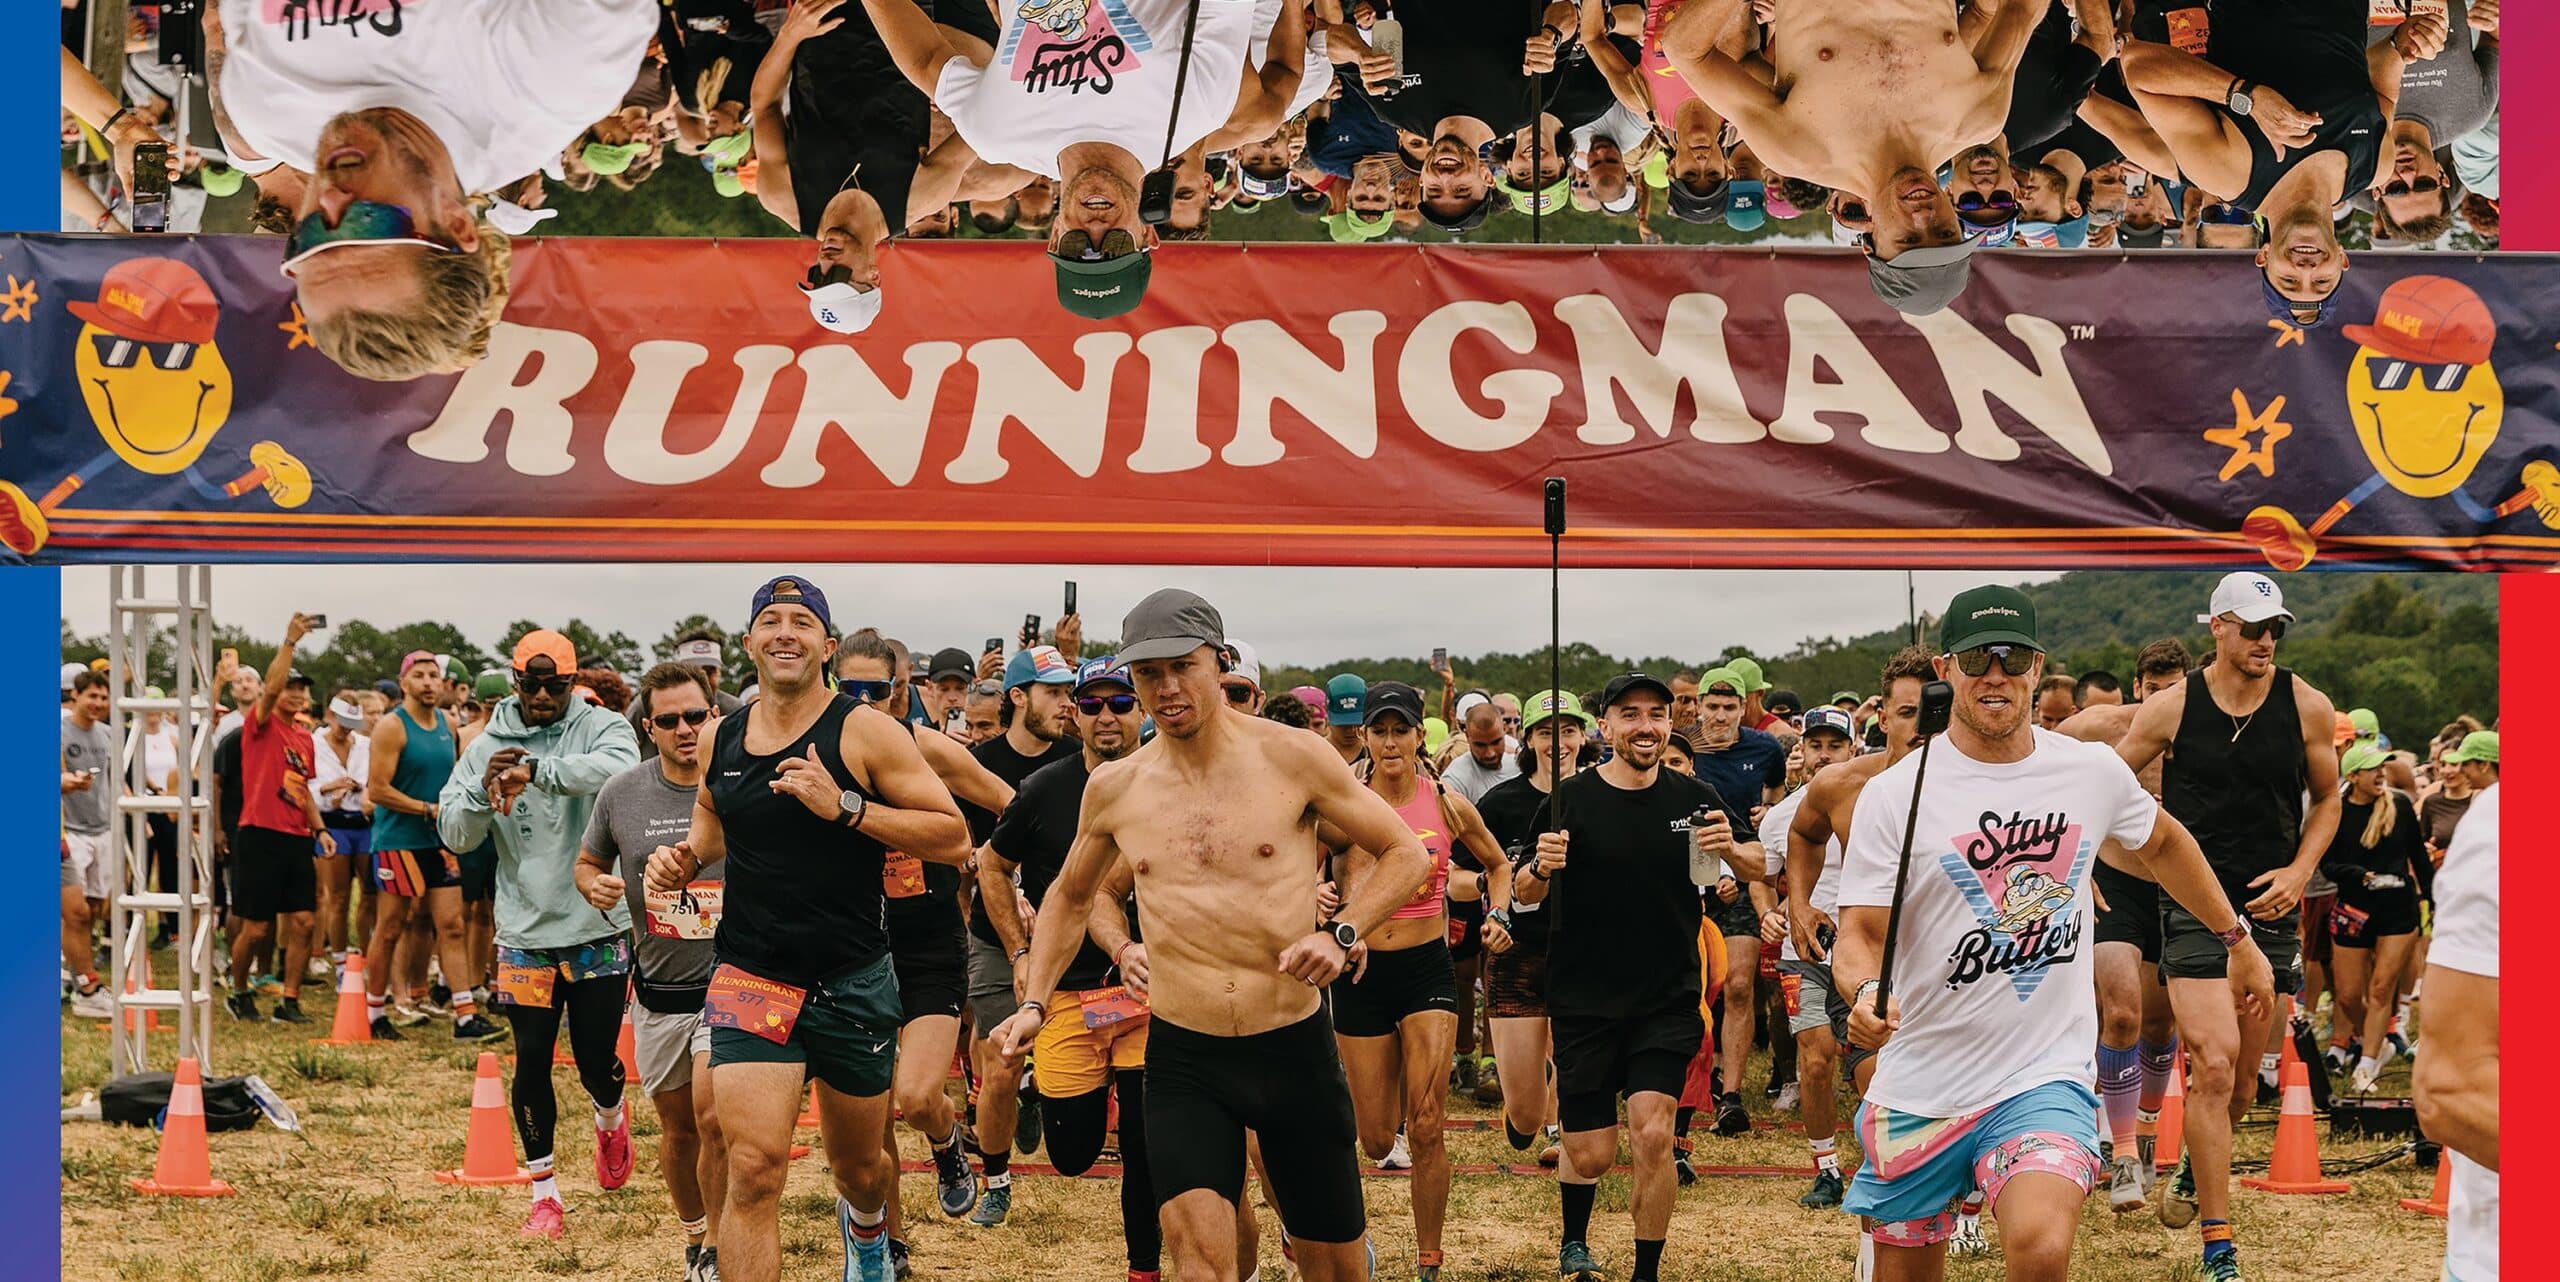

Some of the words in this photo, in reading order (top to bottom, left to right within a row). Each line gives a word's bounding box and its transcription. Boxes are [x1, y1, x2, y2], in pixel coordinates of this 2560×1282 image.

[1023, 35, 1125, 95] Stay
[407, 293, 2113, 490] RUNNINGMAN
[1967, 811, 2069, 870] Stay
[648, 891, 719, 901] RUNNIMAN
[671, 904, 692, 915] 751
[653, 923, 672, 936] 50K
[1948, 910, 2082, 984] Buttery
[510, 974, 529, 984] 321
[716, 976, 798, 1000] RUNNINGMAN
[737, 992, 765, 1006] 577
[709, 1014, 732, 1024] 26.2
[1095, 1013, 1117, 1024] 26.2
